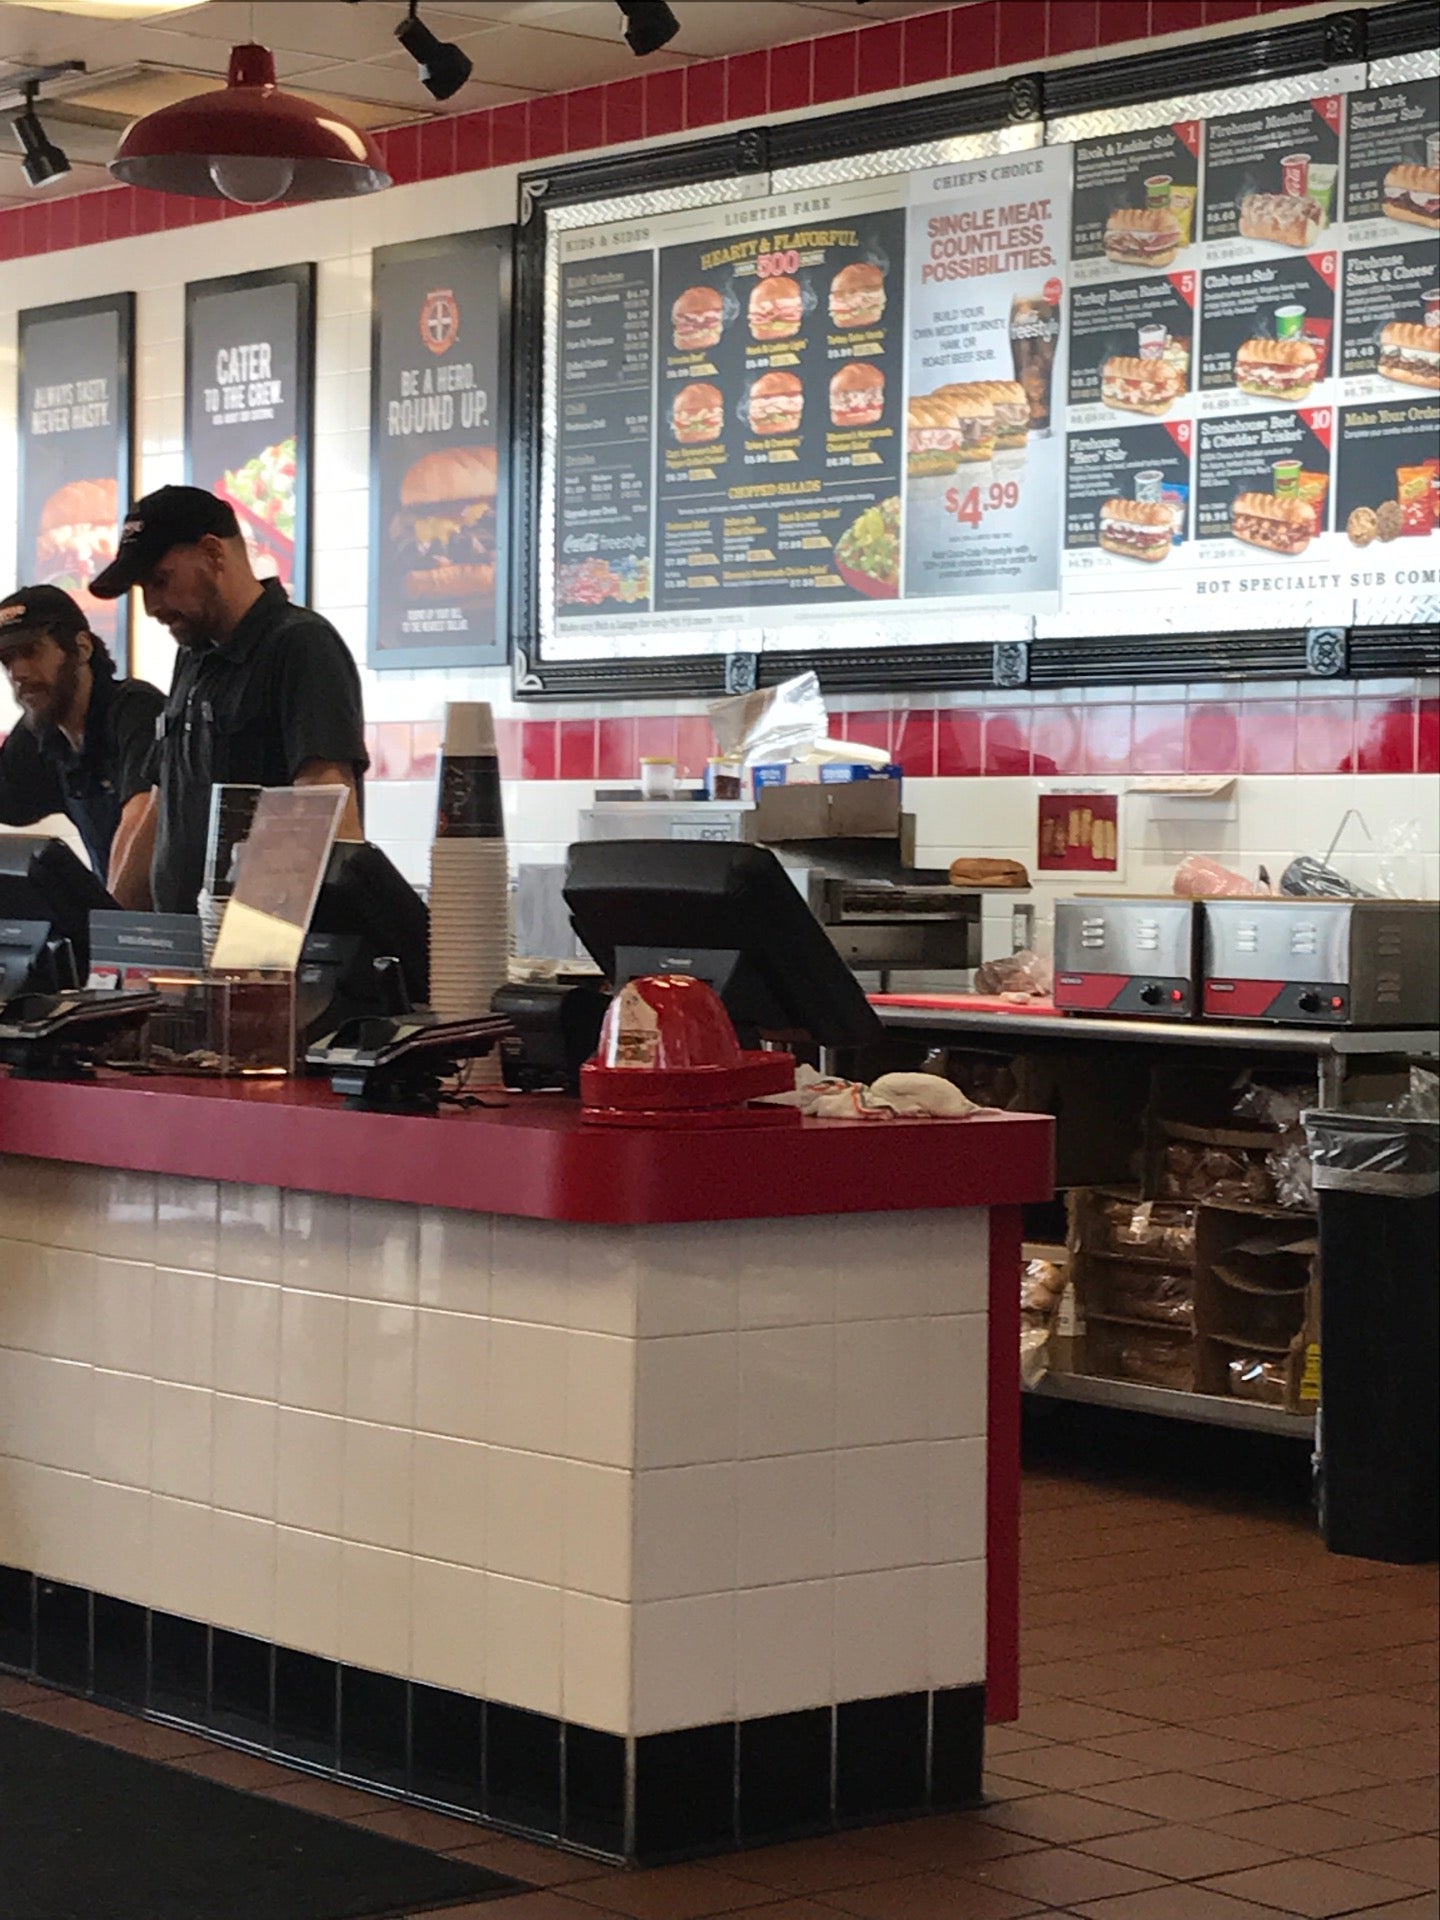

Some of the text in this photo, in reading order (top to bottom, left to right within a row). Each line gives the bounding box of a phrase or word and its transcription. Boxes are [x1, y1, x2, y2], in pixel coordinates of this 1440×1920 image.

[1187, 125, 1197, 143] 1
[933, 160, 1044, 190] CHIEF'S CHOICE
[725, 207, 787, 226] LIGHTER
[927, 199, 1052, 238] SINGLE MEAT.
[700, 240, 758, 271] HEARTY
[758, 237, 771, 253] &
[773, 229, 859, 250] FLAVORFUL
[930, 224, 1044, 260] COUNTLESS
[757, 249, 799, 278] 500
[921, 246, 1056, 284] POSSIBILITIES.
[1321, 255, 1334, 274] 6
[1347, 255, 1404, 271] Firehouse
[1181, 275, 1193, 293] 5
[1346, 264, 1435, 286] Steak & Cheese
[960, 306, 984, 319] YOUR
[963, 337, 976, 348] OR
[217, 342, 272, 385] CATER
[76, 378, 109, 402] TASTY.
[401, 363, 478, 396] BE A HERO.
[204, 379, 284, 412] TO THE CREW.
[32, 402, 110, 435] NEVER HASTY.
[388, 390, 489, 436] ROUND UP.
[1311, 409, 1331, 430] 10
[1345, 412, 1377, 427] Make
[1378, 409, 1407, 424] Your
[1177, 424, 1190, 442] 9
[1201, 414, 1296, 436] Smokehouse Beef
[1201, 429, 1303, 450] & Cheddar Brisket
[777, 479, 822, 495] SALADS
[944, 481, 1019, 530] $4.99
[1197, 569, 1440, 594] HOT SPECIALTY SUB COM
